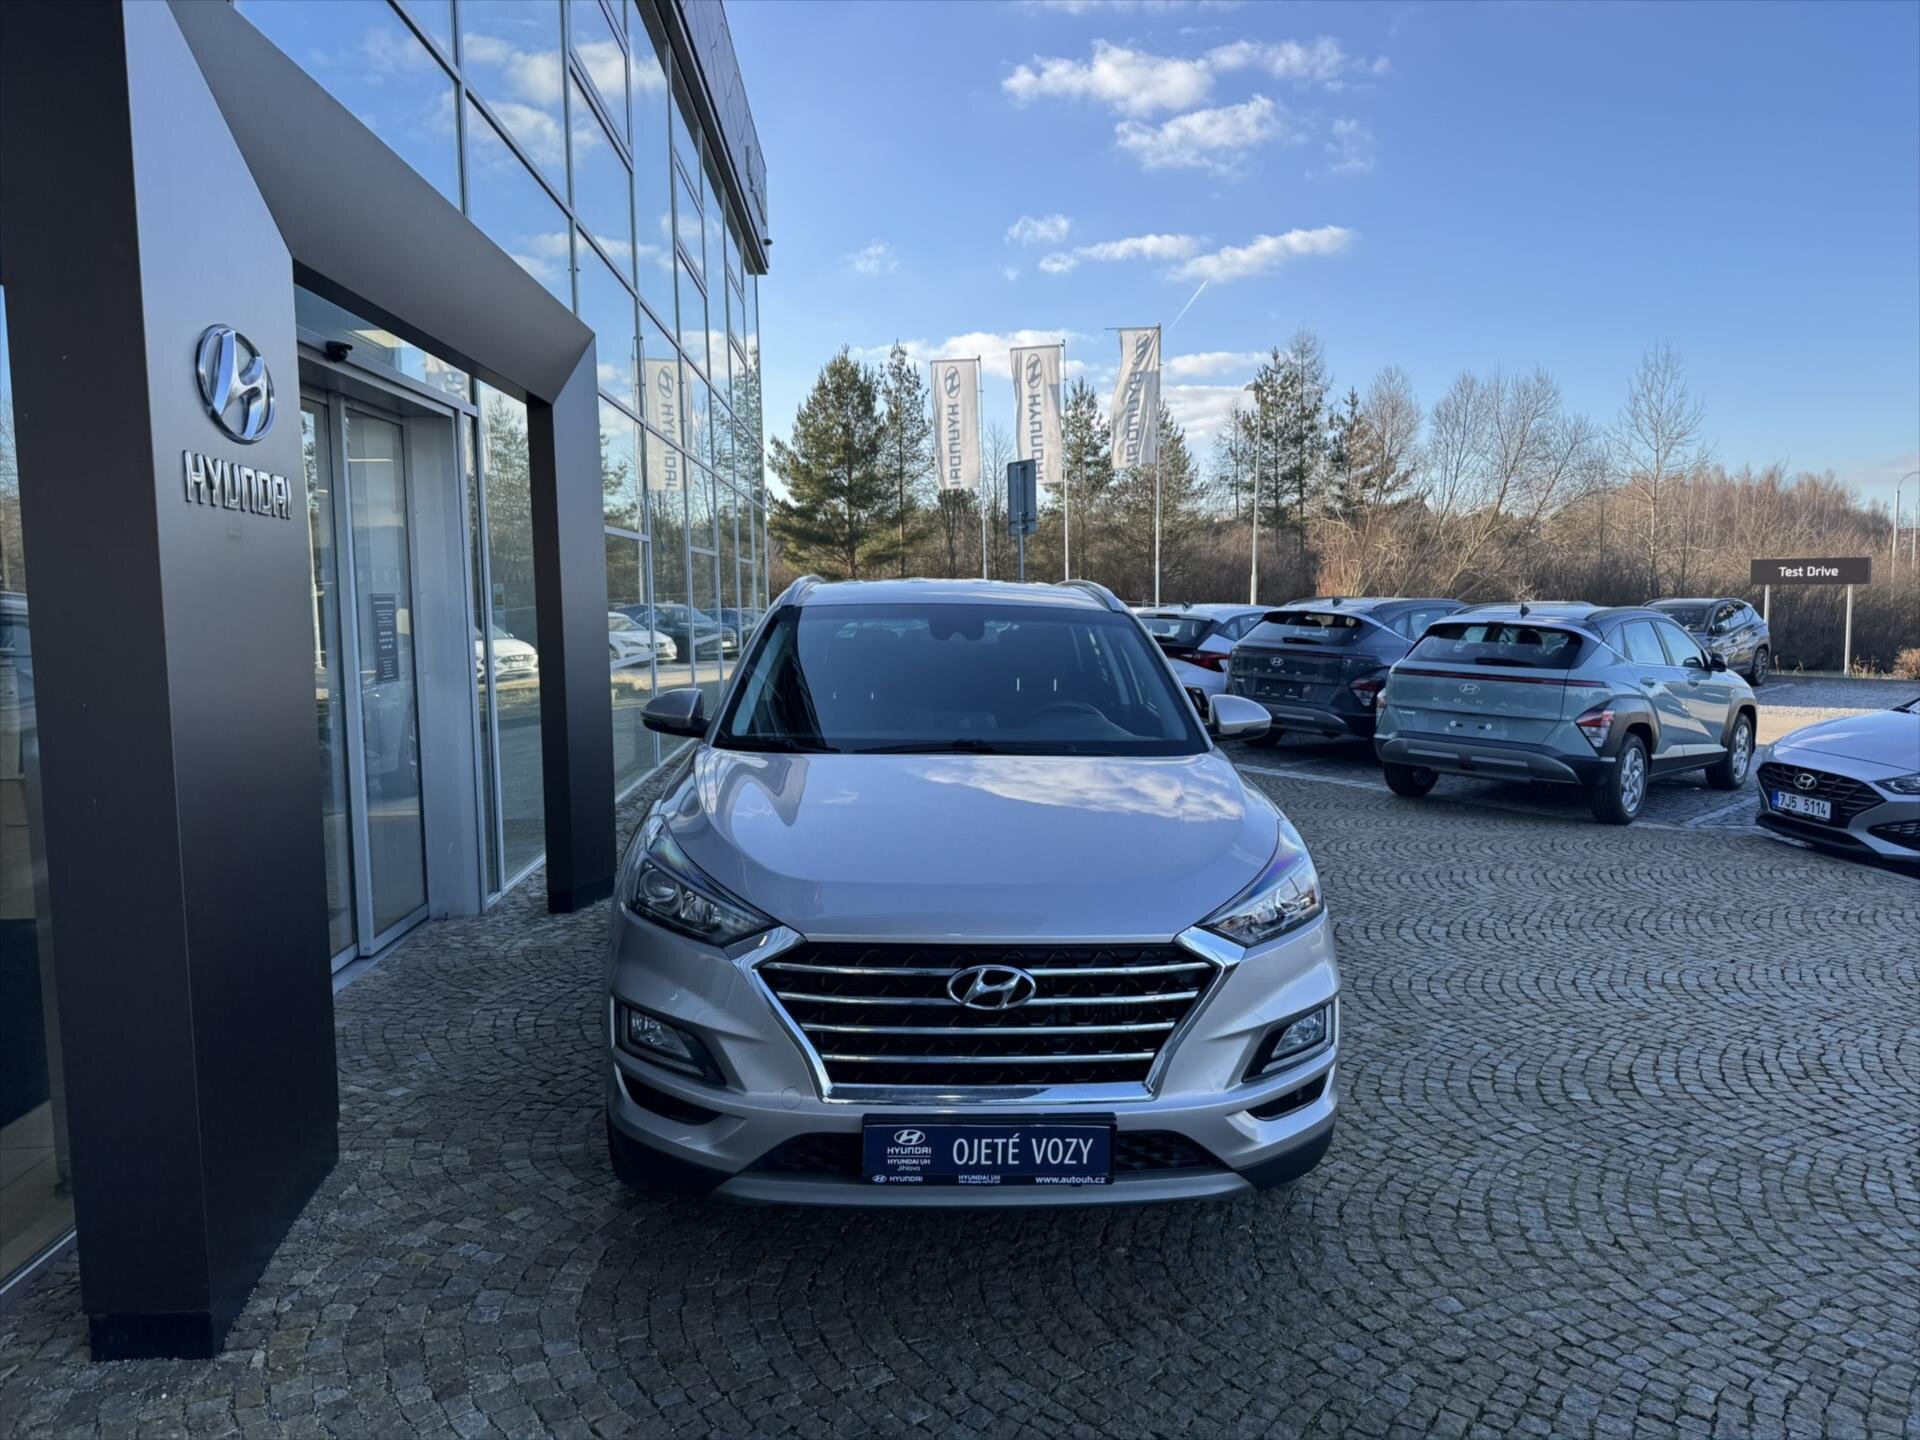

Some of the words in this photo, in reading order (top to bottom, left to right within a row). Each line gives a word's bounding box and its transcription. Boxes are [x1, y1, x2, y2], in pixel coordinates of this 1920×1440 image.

[183, 450, 291, 520] HYUNDAI
[1779, 566, 1803, 577] Test
[1807, 566, 1838, 577] Drive
[1780, 793, 1797, 808] 7J5
[1804, 798, 1826, 815] 5114
[887, 1147, 932, 1155] HYUNDAI
[952, 1133, 1020, 1165] OJETÉ
[1032, 1138, 1094, 1165] VOZY
[1035, 1175, 1106, 1184] www.autouh.cz
